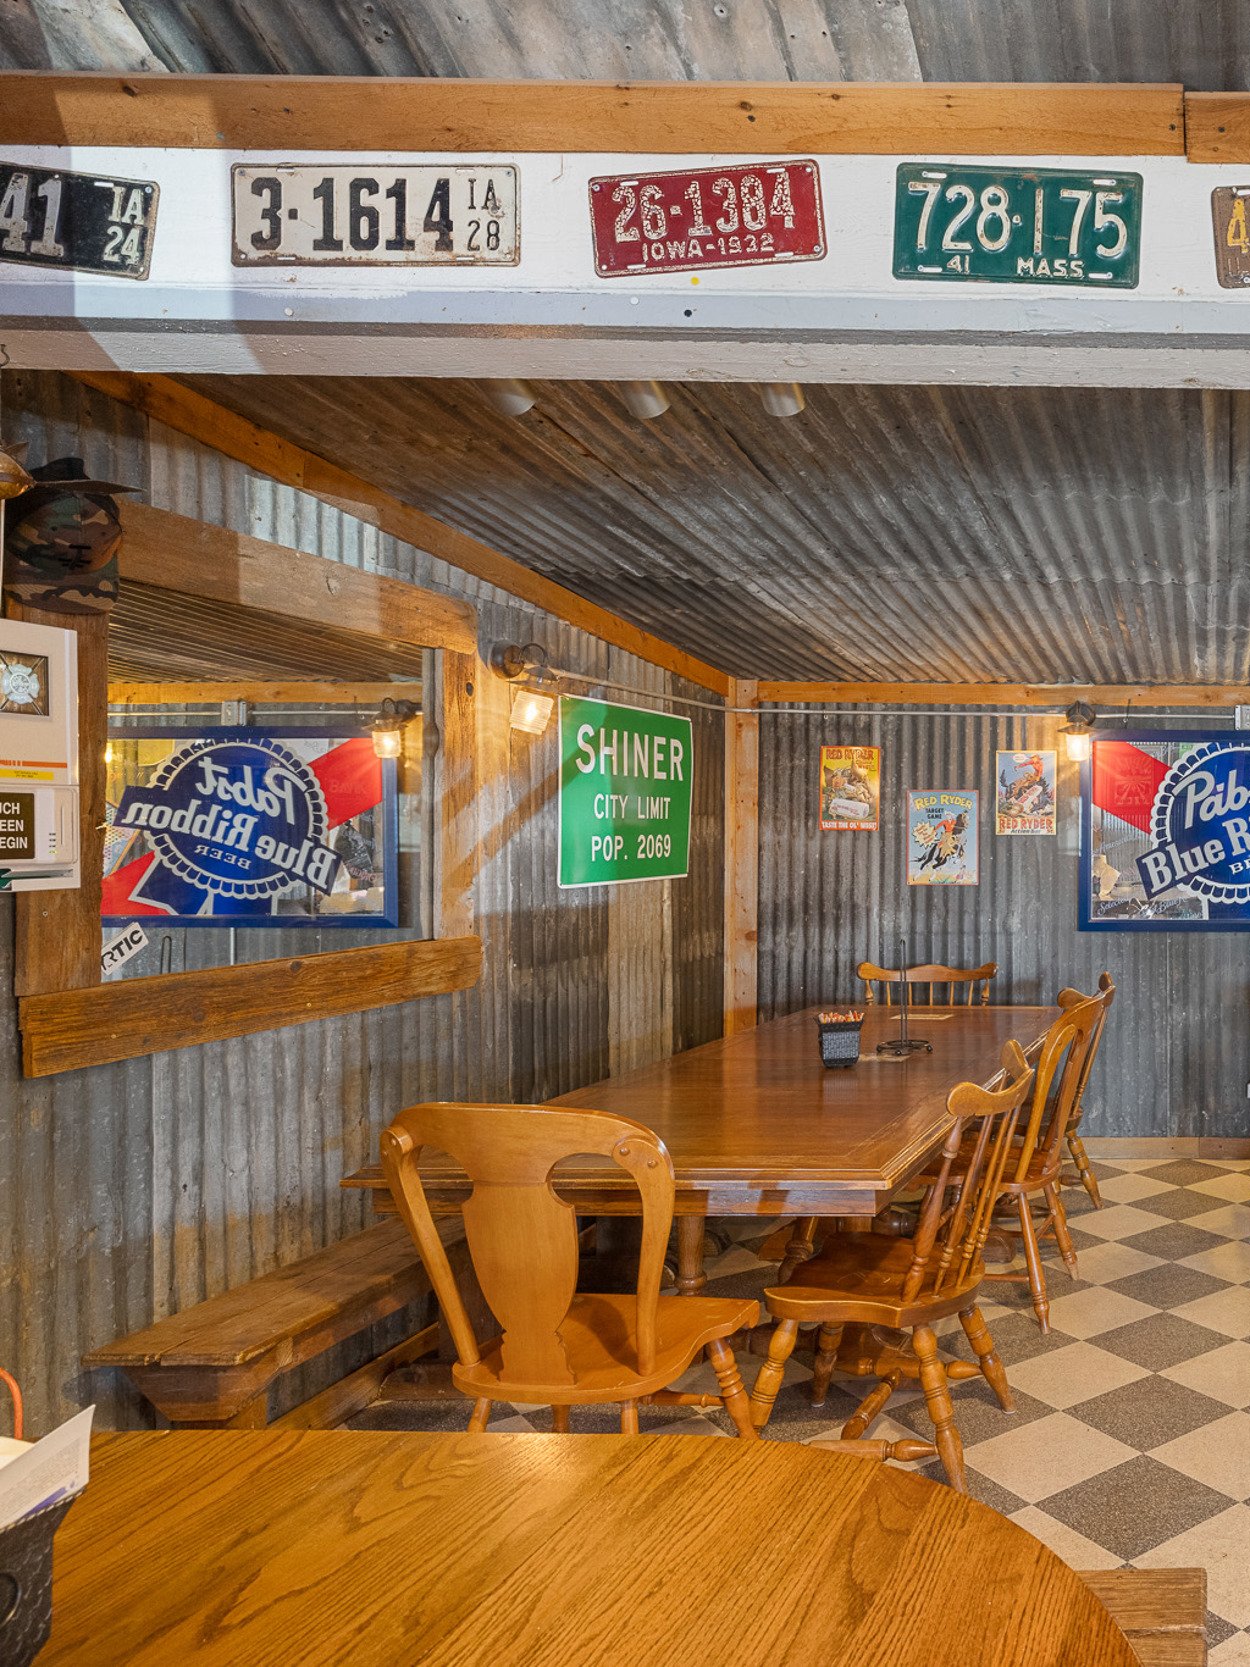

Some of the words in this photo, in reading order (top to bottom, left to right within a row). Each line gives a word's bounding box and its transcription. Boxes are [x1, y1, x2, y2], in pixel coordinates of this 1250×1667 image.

[112, 185, 144, 226] IA
[467, 178, 500, 212] IA
[103, 225, 141, 264] 24
[466, 219, 501, 252] 28
[946, 254, 970, 274] 41
[1016, 256, 1085, 278] MASS
[575, 723, 684, 782] SHINER
[593, 793, 629, 820] CITY
[637, 796, 671, 820] LIMIT
[914, 796, 937, 811] RED
[940, 794, 973, 810] RYDER
[999, 816, 1018, 831] RED
[1020, 816, 1053, 831] RYDER
[591, 835, 629, 862] POP.
[636, 834, 672, 859] 2069
[1142, 838, 1225, 895] Blue
